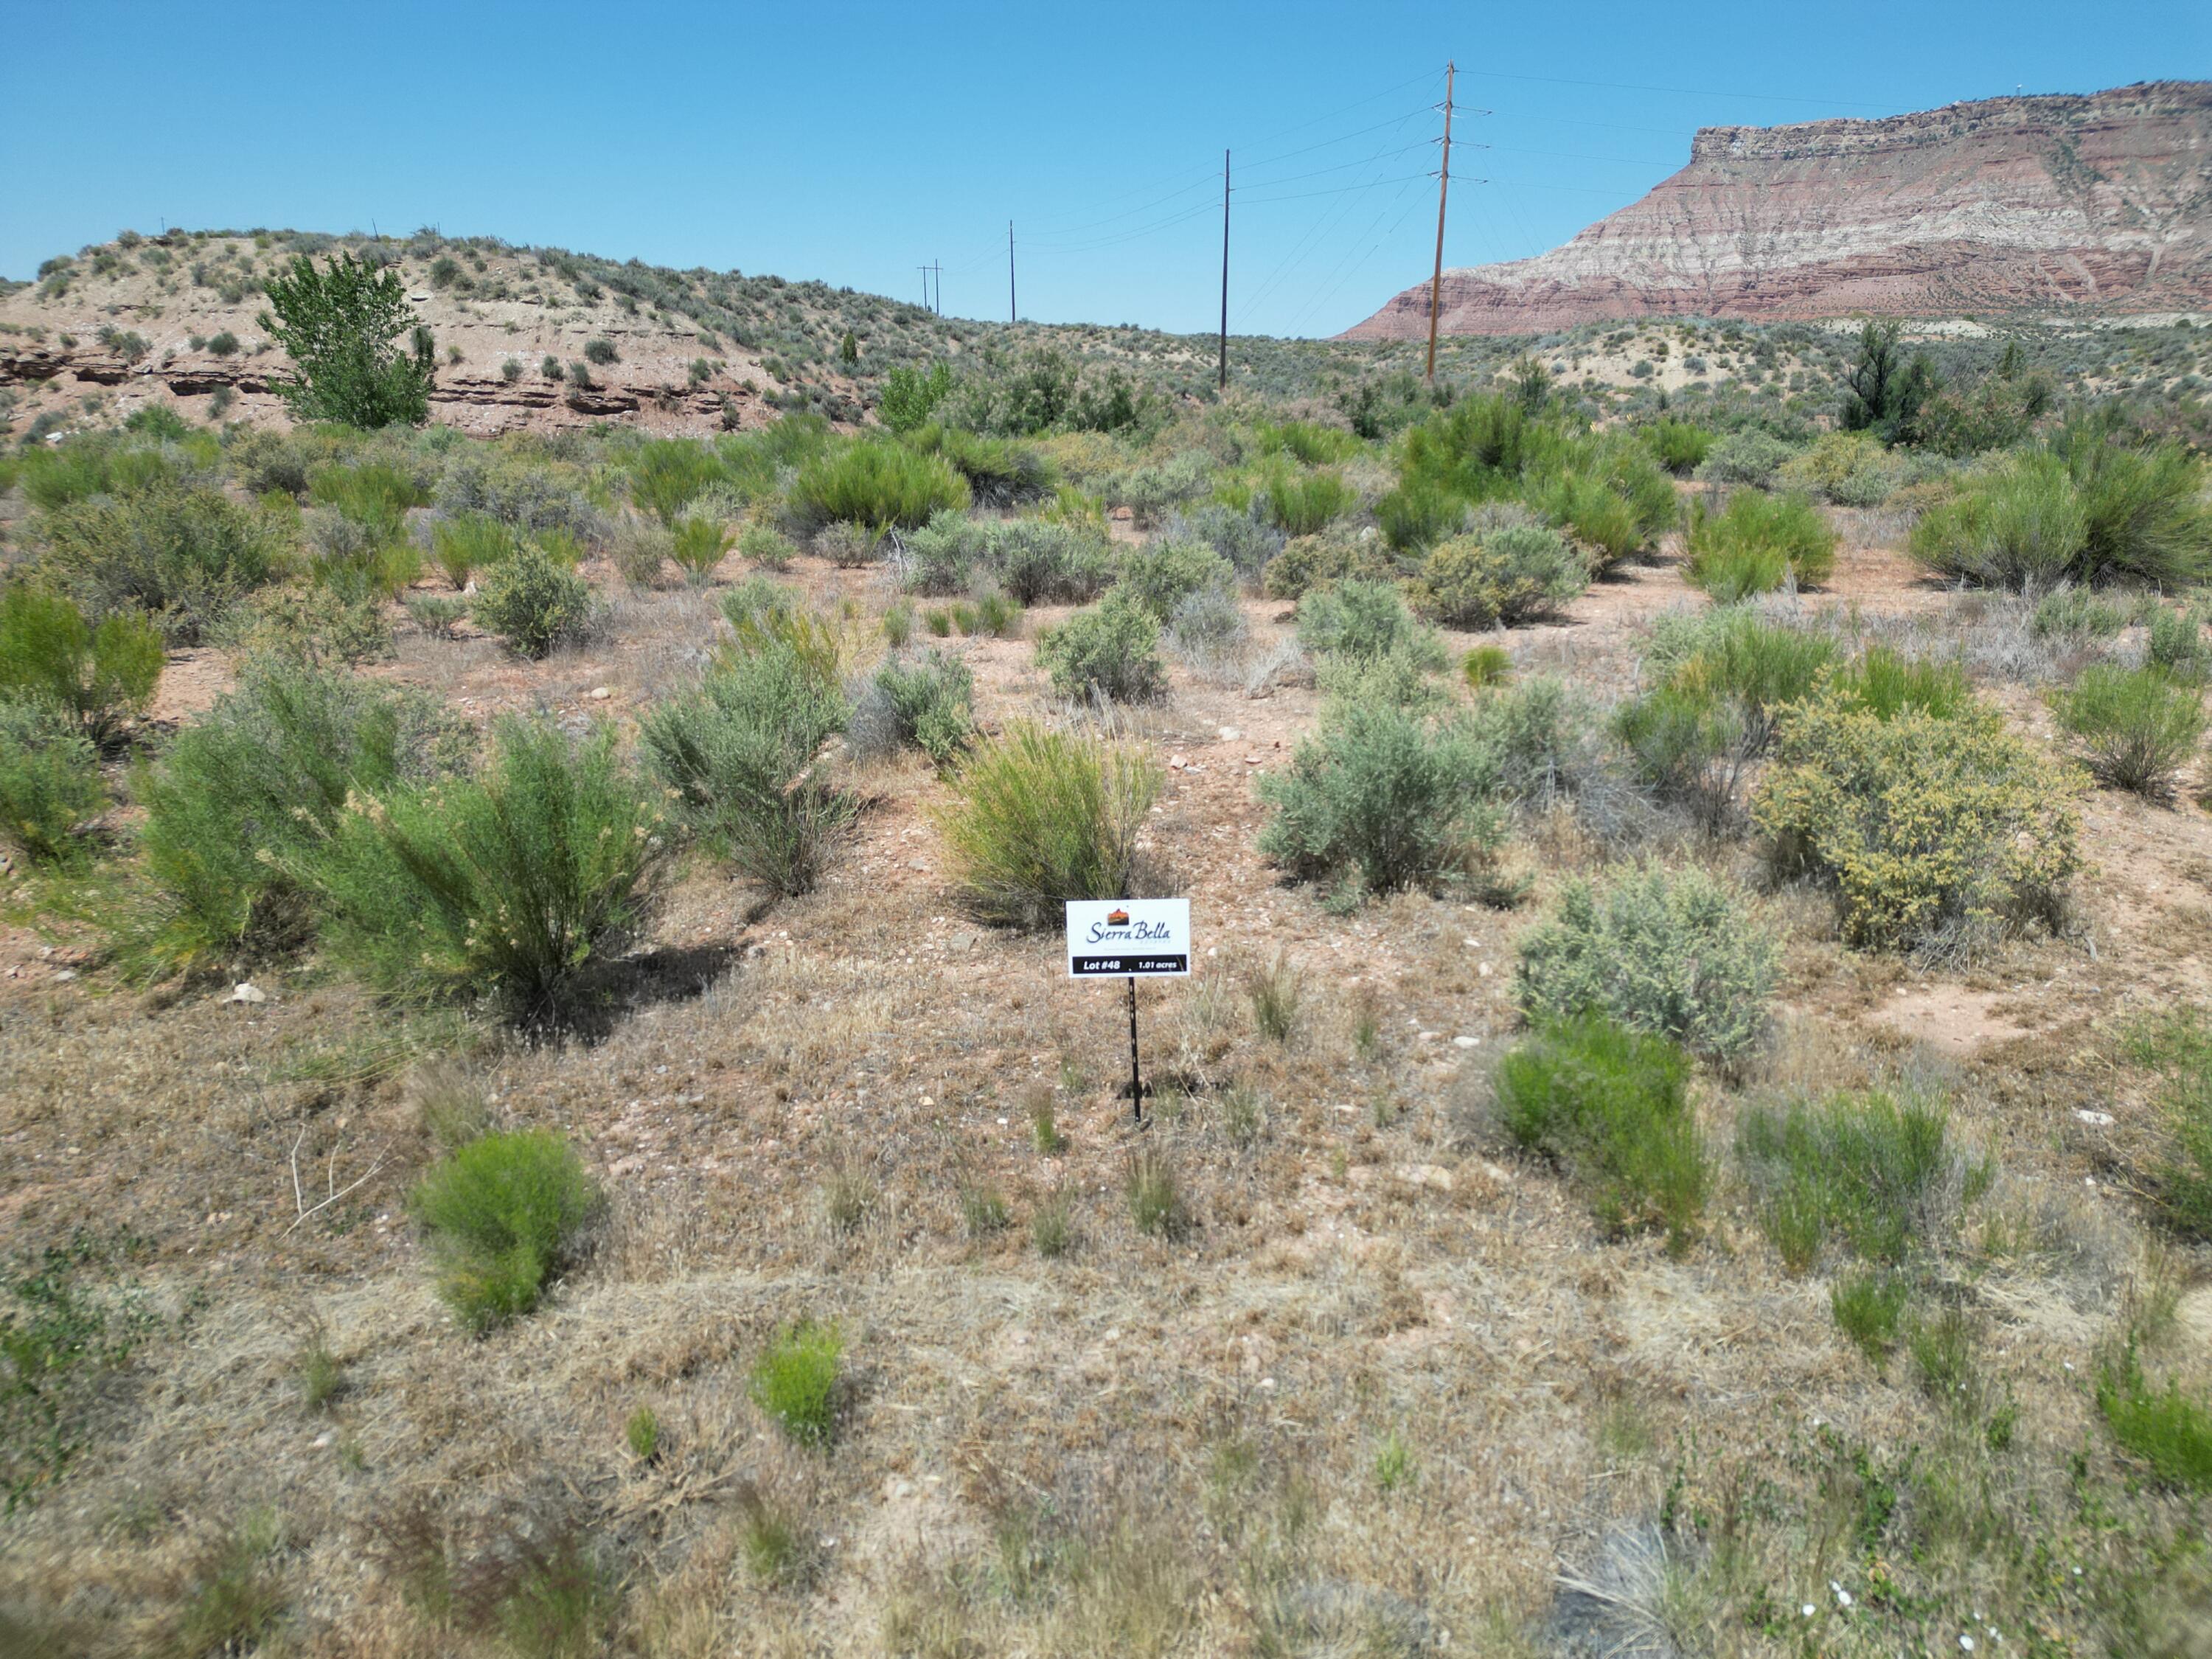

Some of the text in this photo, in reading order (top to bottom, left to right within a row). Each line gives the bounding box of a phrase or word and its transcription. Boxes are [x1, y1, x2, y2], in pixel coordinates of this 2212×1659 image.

[1086, 920, 1171, 943] Sierra Bella
[1083, 960, 1120, 970] Lot #48
